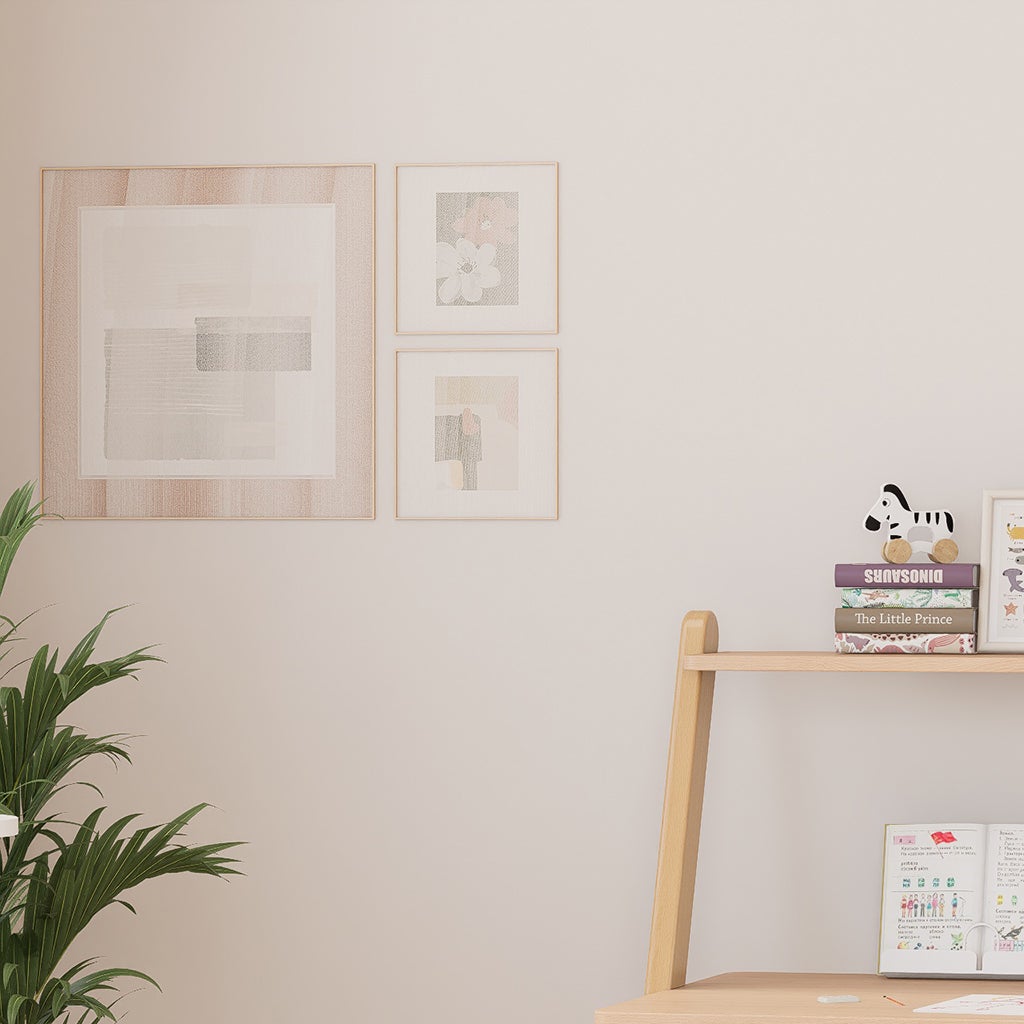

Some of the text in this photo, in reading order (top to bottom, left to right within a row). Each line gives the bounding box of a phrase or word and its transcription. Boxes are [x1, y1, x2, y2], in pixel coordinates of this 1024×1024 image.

[864, 569, 943, 584] DINOSAURS
[855, 612, 953, 625] The Little Prince
